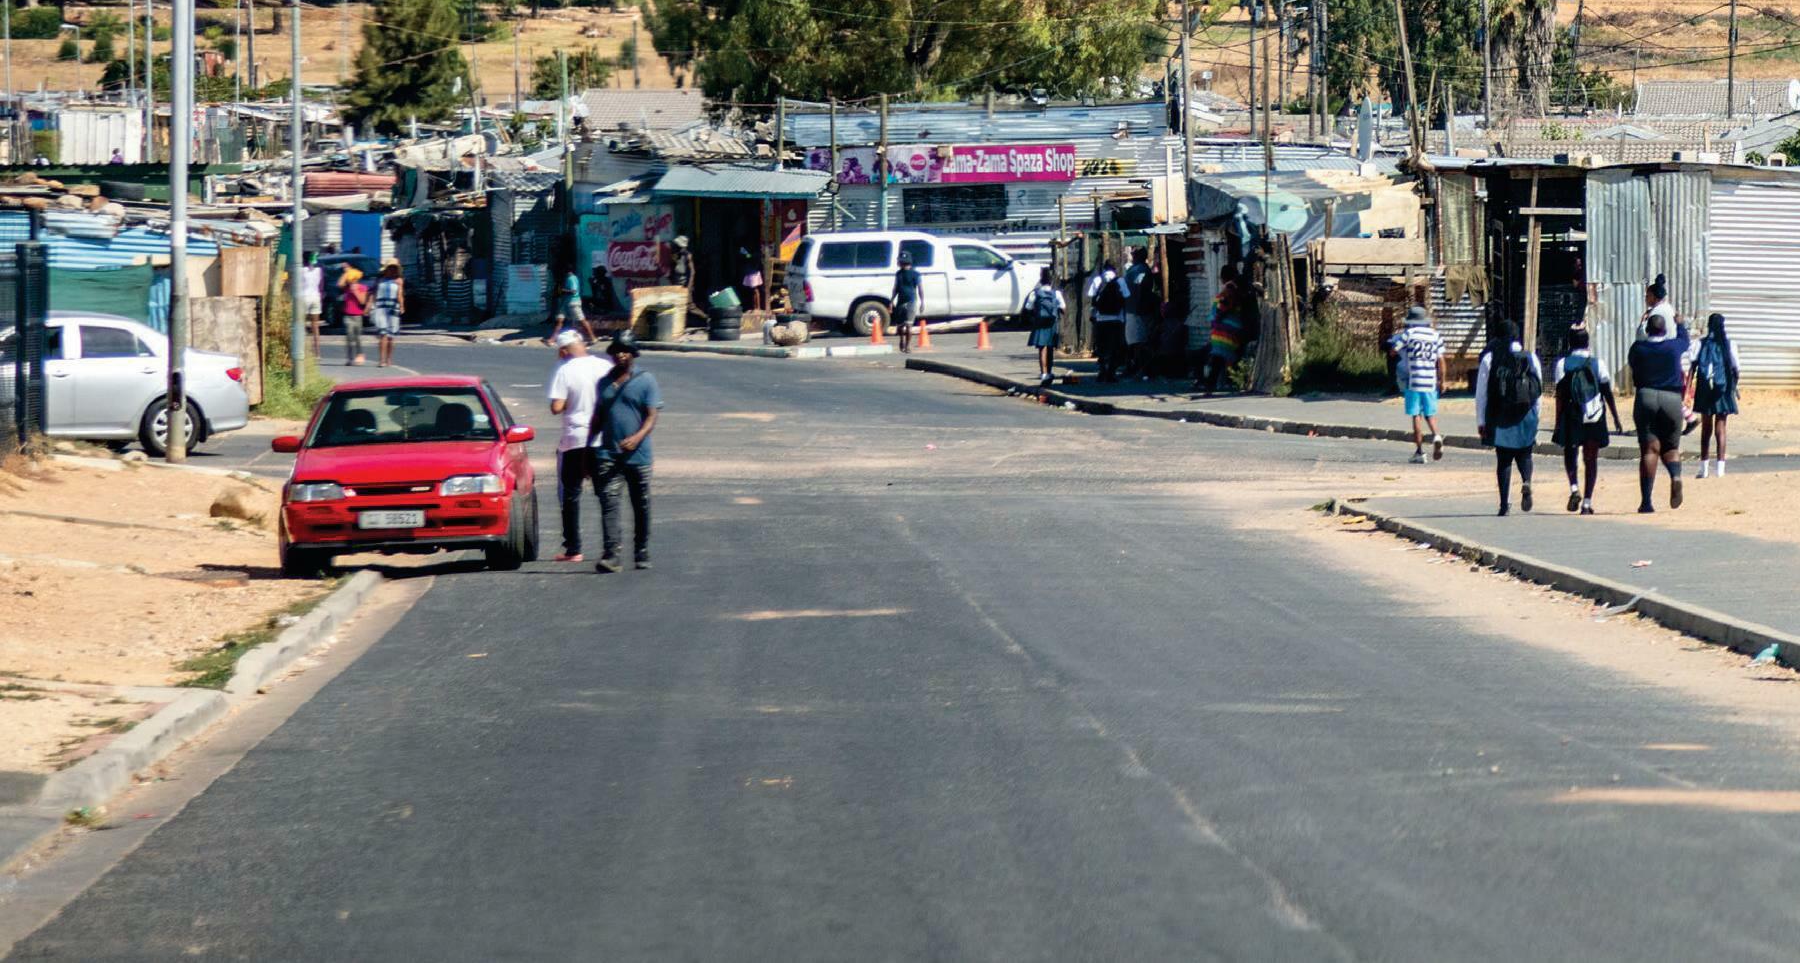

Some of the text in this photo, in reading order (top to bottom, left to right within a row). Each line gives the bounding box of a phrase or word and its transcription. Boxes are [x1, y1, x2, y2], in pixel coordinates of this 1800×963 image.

[942, 147, 1075, 178] Zama-Zama Spaza Shop
[1413, 340, 1433, 359] 23
